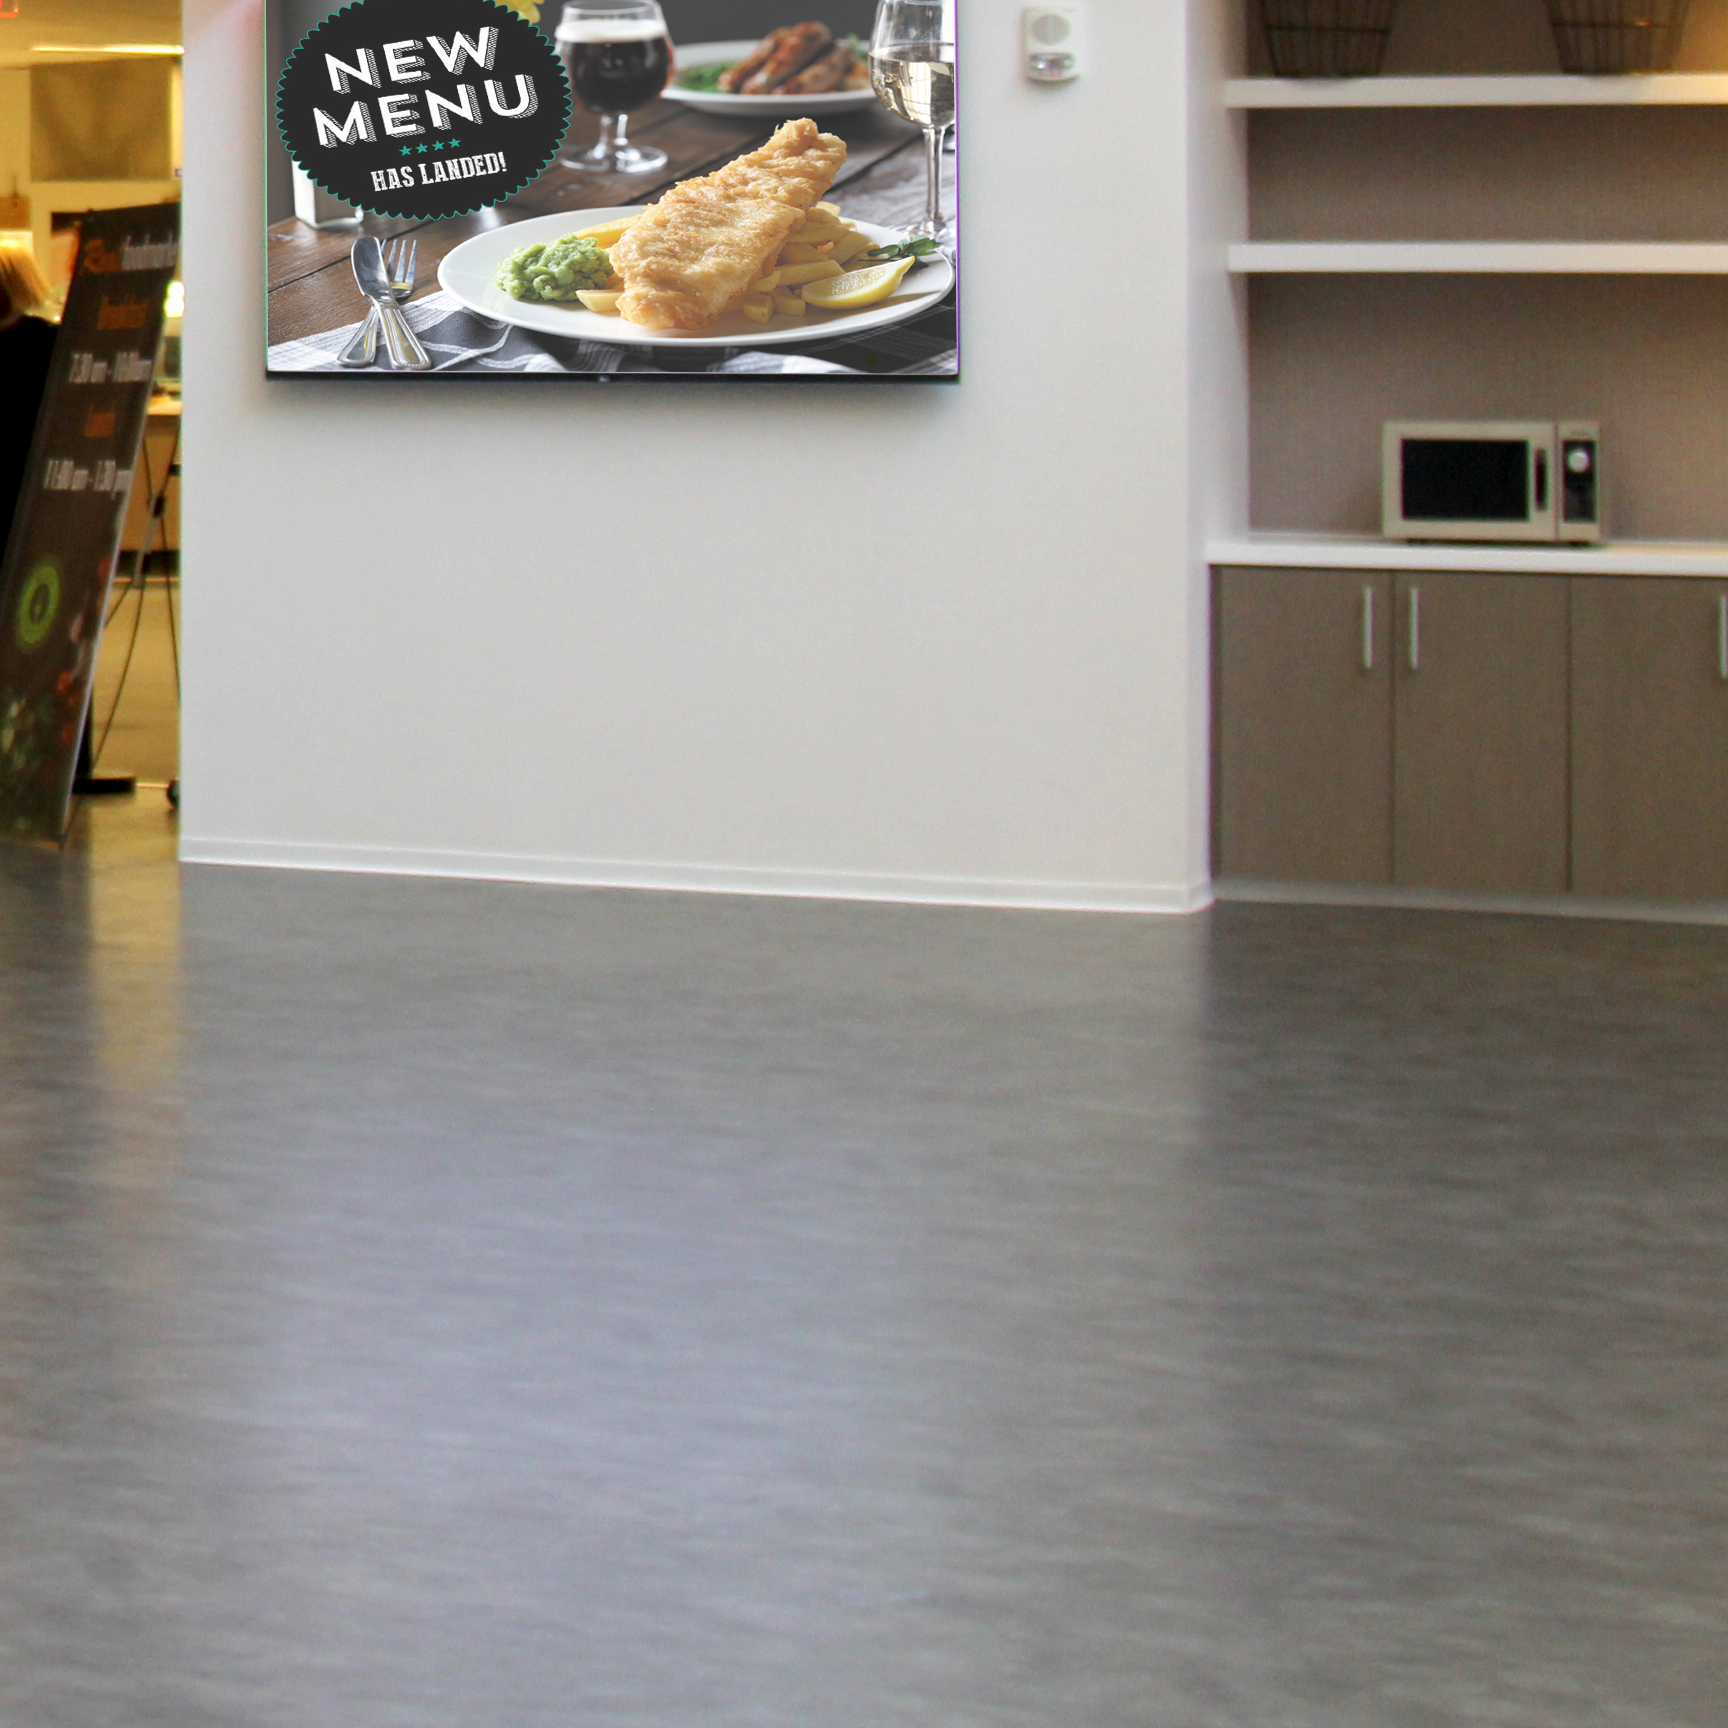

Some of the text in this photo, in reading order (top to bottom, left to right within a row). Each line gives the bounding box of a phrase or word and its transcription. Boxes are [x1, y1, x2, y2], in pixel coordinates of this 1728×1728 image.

[324, 26, 500, 95] NEW
[312, 74, 539, 149] MENU
[370, 152, 508, 192] HAS LANDED!
